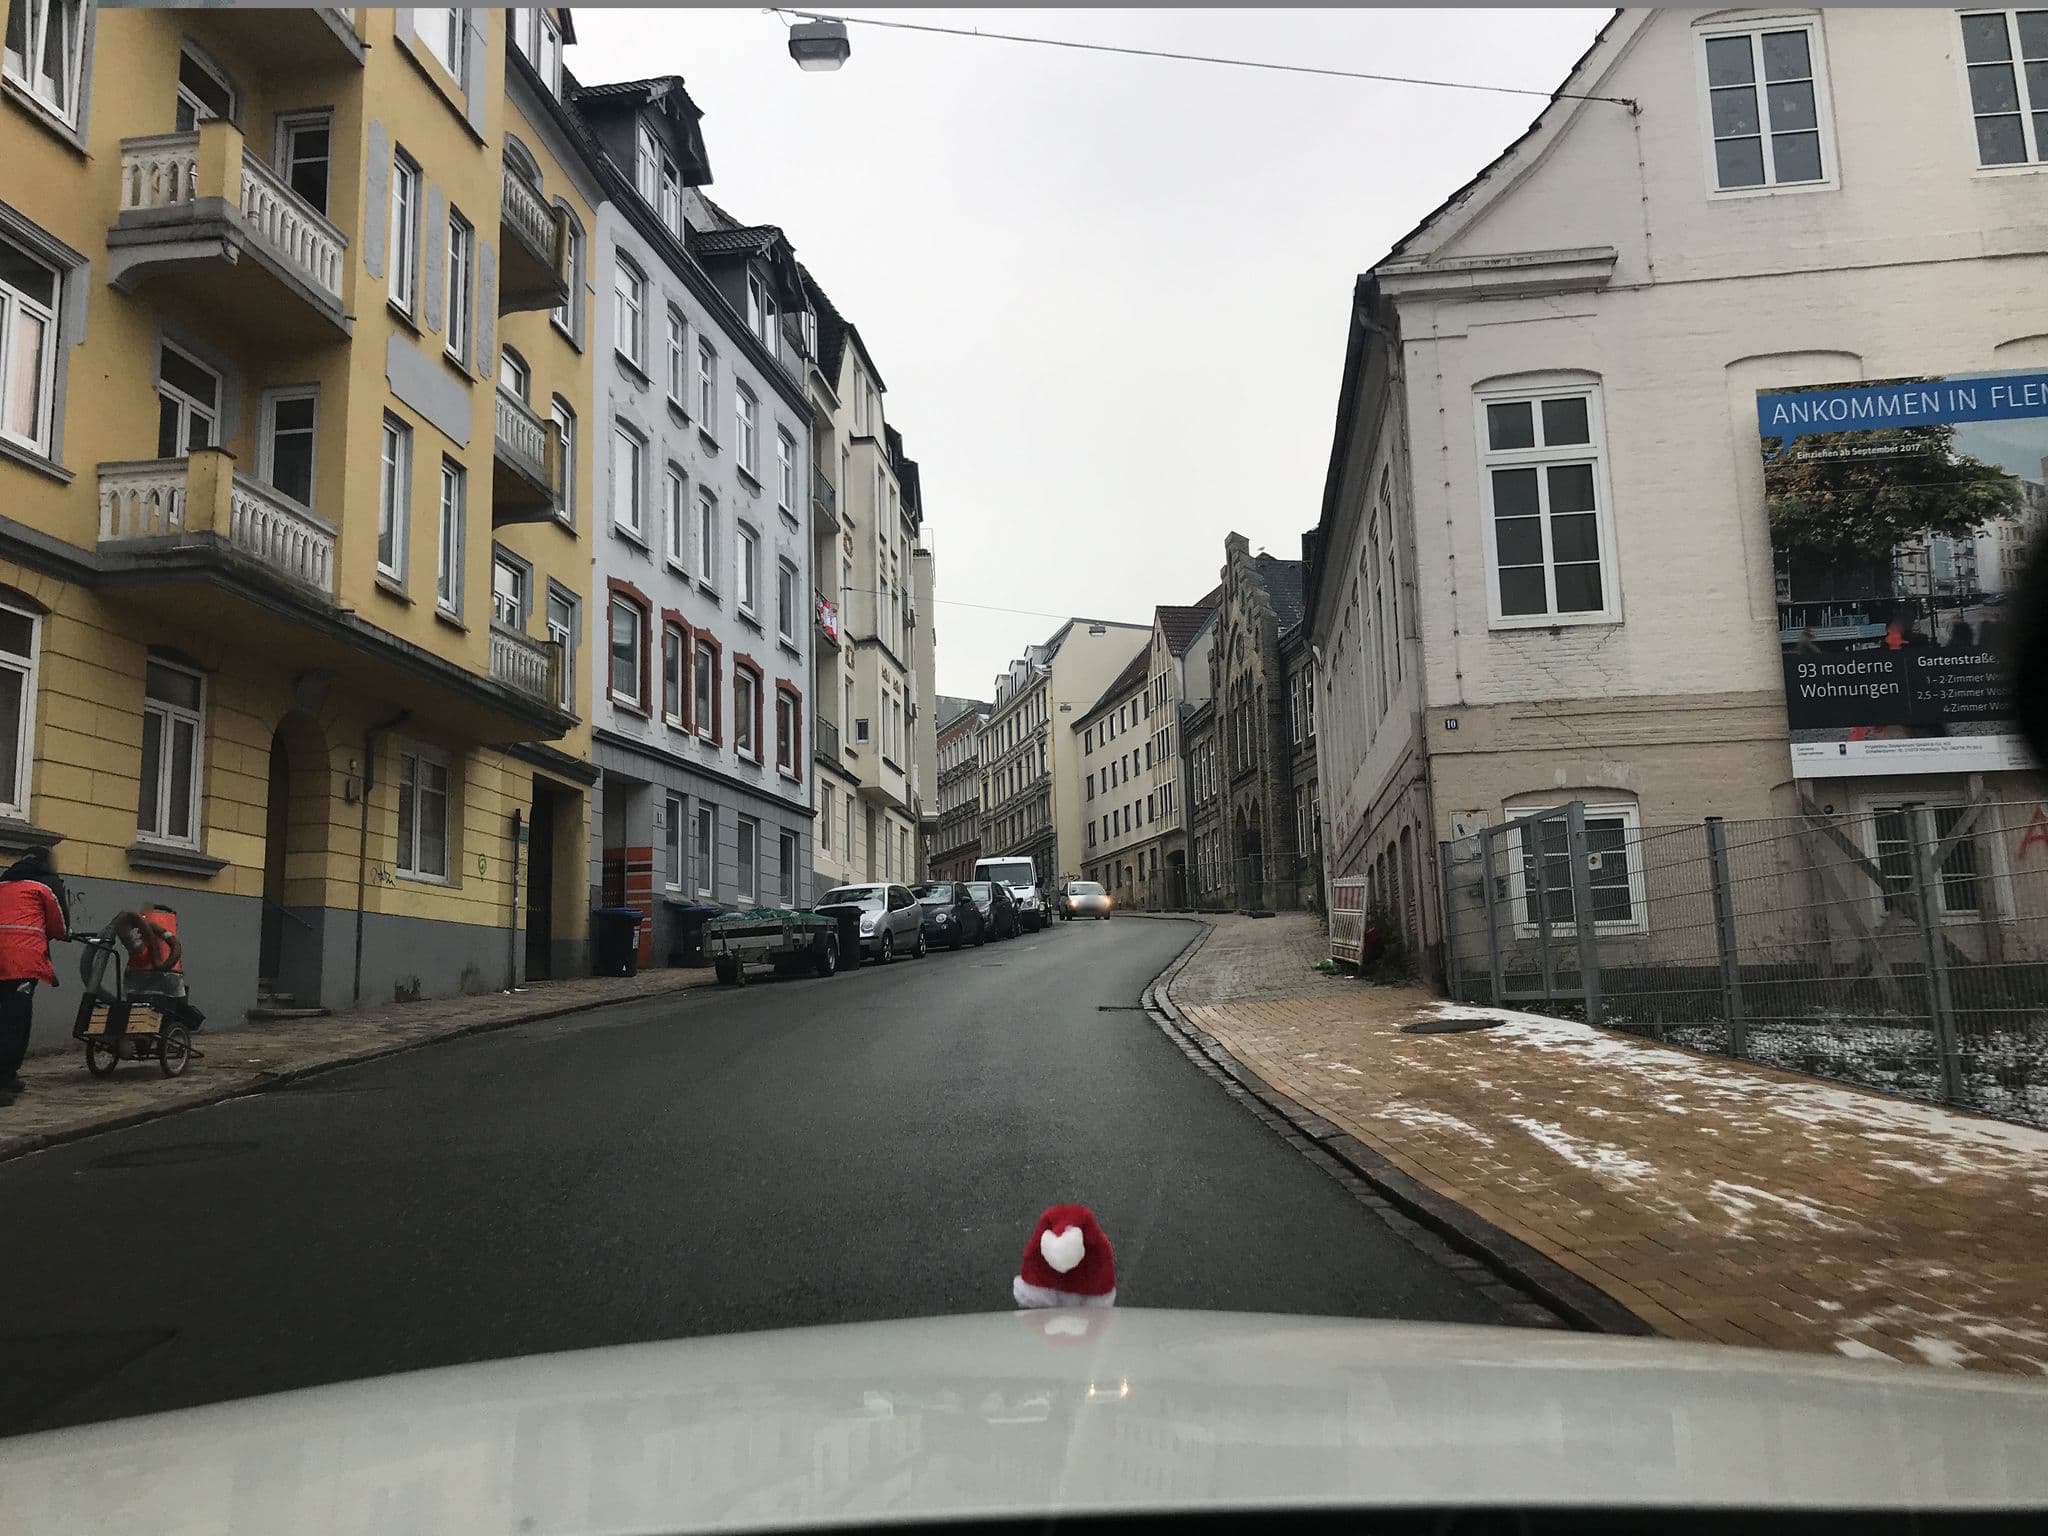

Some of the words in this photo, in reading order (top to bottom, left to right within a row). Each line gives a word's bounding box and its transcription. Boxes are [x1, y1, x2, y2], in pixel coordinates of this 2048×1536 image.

[1772, 390, 1940, 425] ANKOMMEN
[1949, 387, 1977, 412] IN
[1796, 448, 1839, 460] Einziehen
[1839, 448, 1851, 457] ab
[1851, 445, 1899, 457] September
[1900, 443, 1921, 452] 2017
[1797, 663, 1817, 678] 93
[1821, 659, 1894, 676] moderne
[1799, 681, 1900, 699] Wohnungen
[1446, 719, 1457, 729] 10
